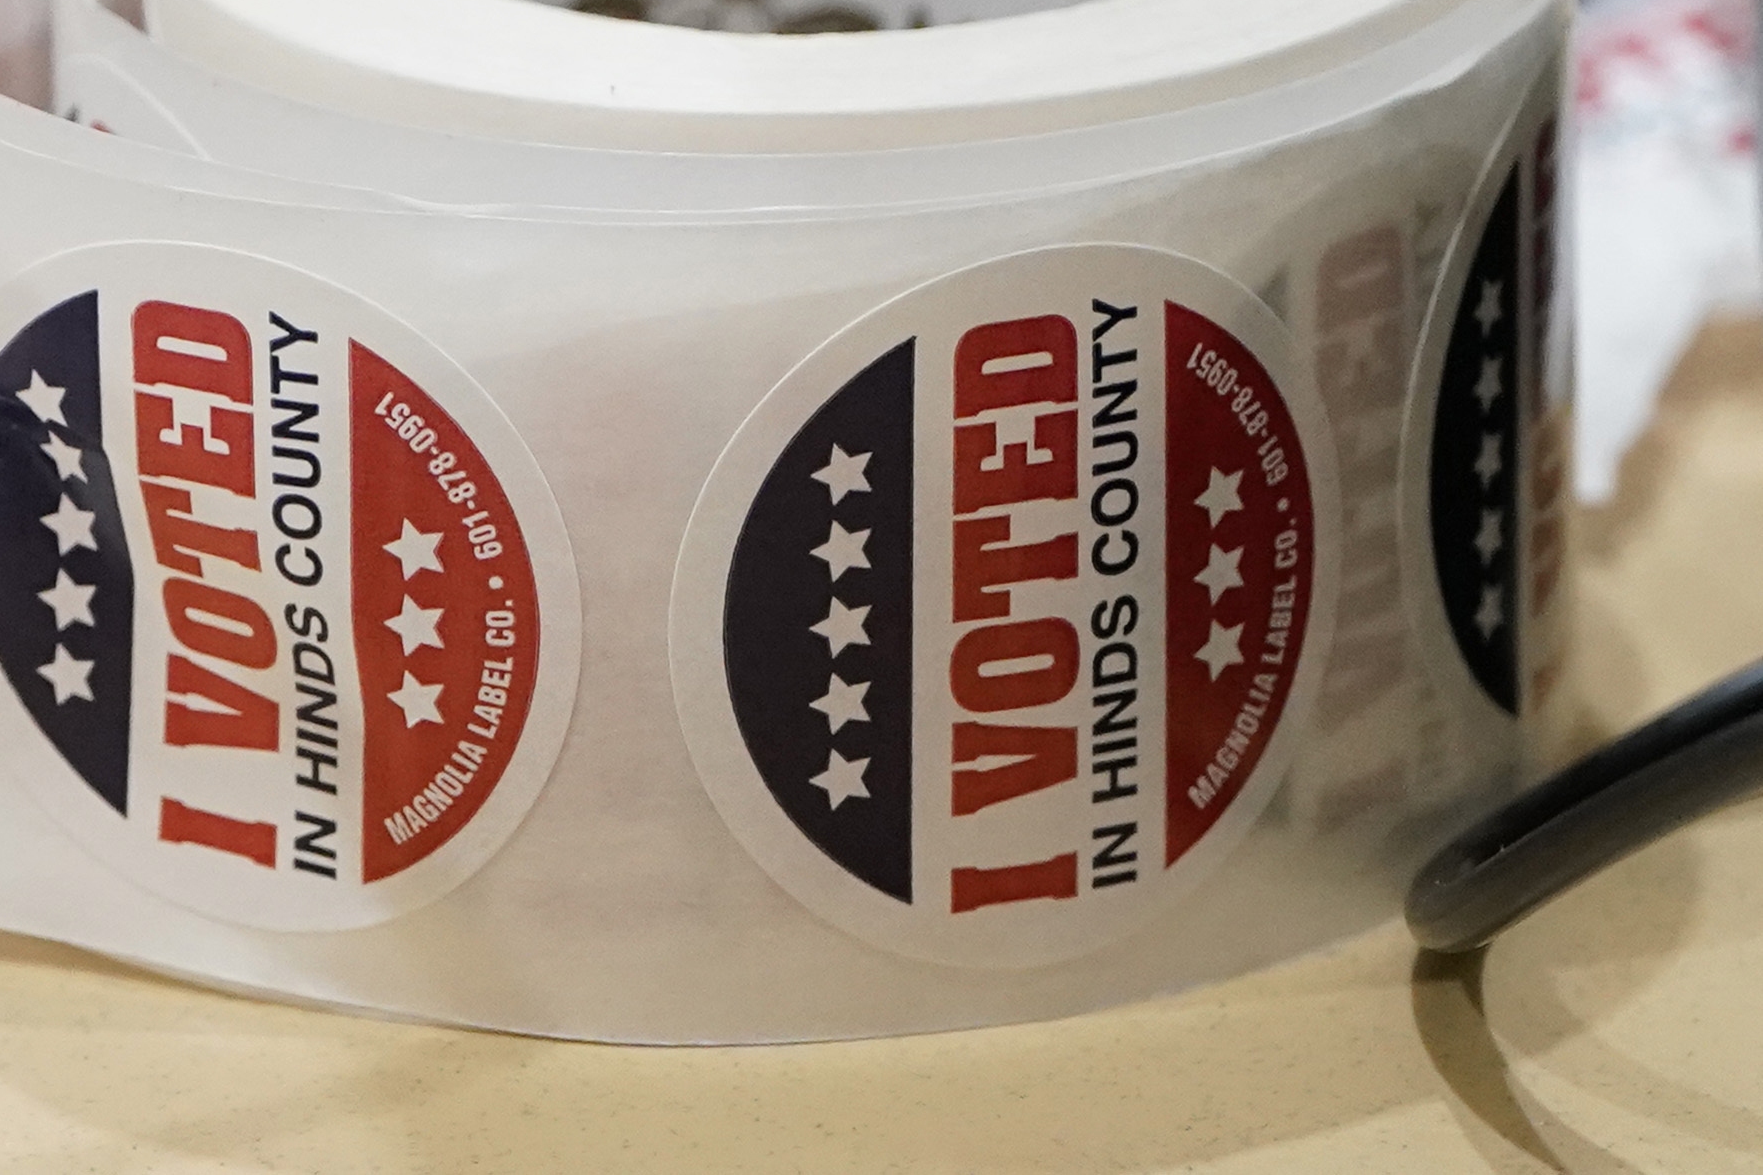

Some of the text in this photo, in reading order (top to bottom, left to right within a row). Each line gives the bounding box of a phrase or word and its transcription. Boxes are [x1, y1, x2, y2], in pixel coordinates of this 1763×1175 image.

[130, 298, 281, 871] I VOTED
[268, 310, 339, 881] IN HINDS COUNTY
[373, 390, 504, 561] 601-878-0951
[948, 312, 1081, 915] I VOTED
[1090, 297, 1140, 890] IN HINDS COUNTY
[1186, 341, 1289, 487] 601-878-0951
[383, 599, 516, 846] MAGNOLIA LABEL CO.
[1187, 516, 1299, 811] MAGNOLIA LABEL CO.
